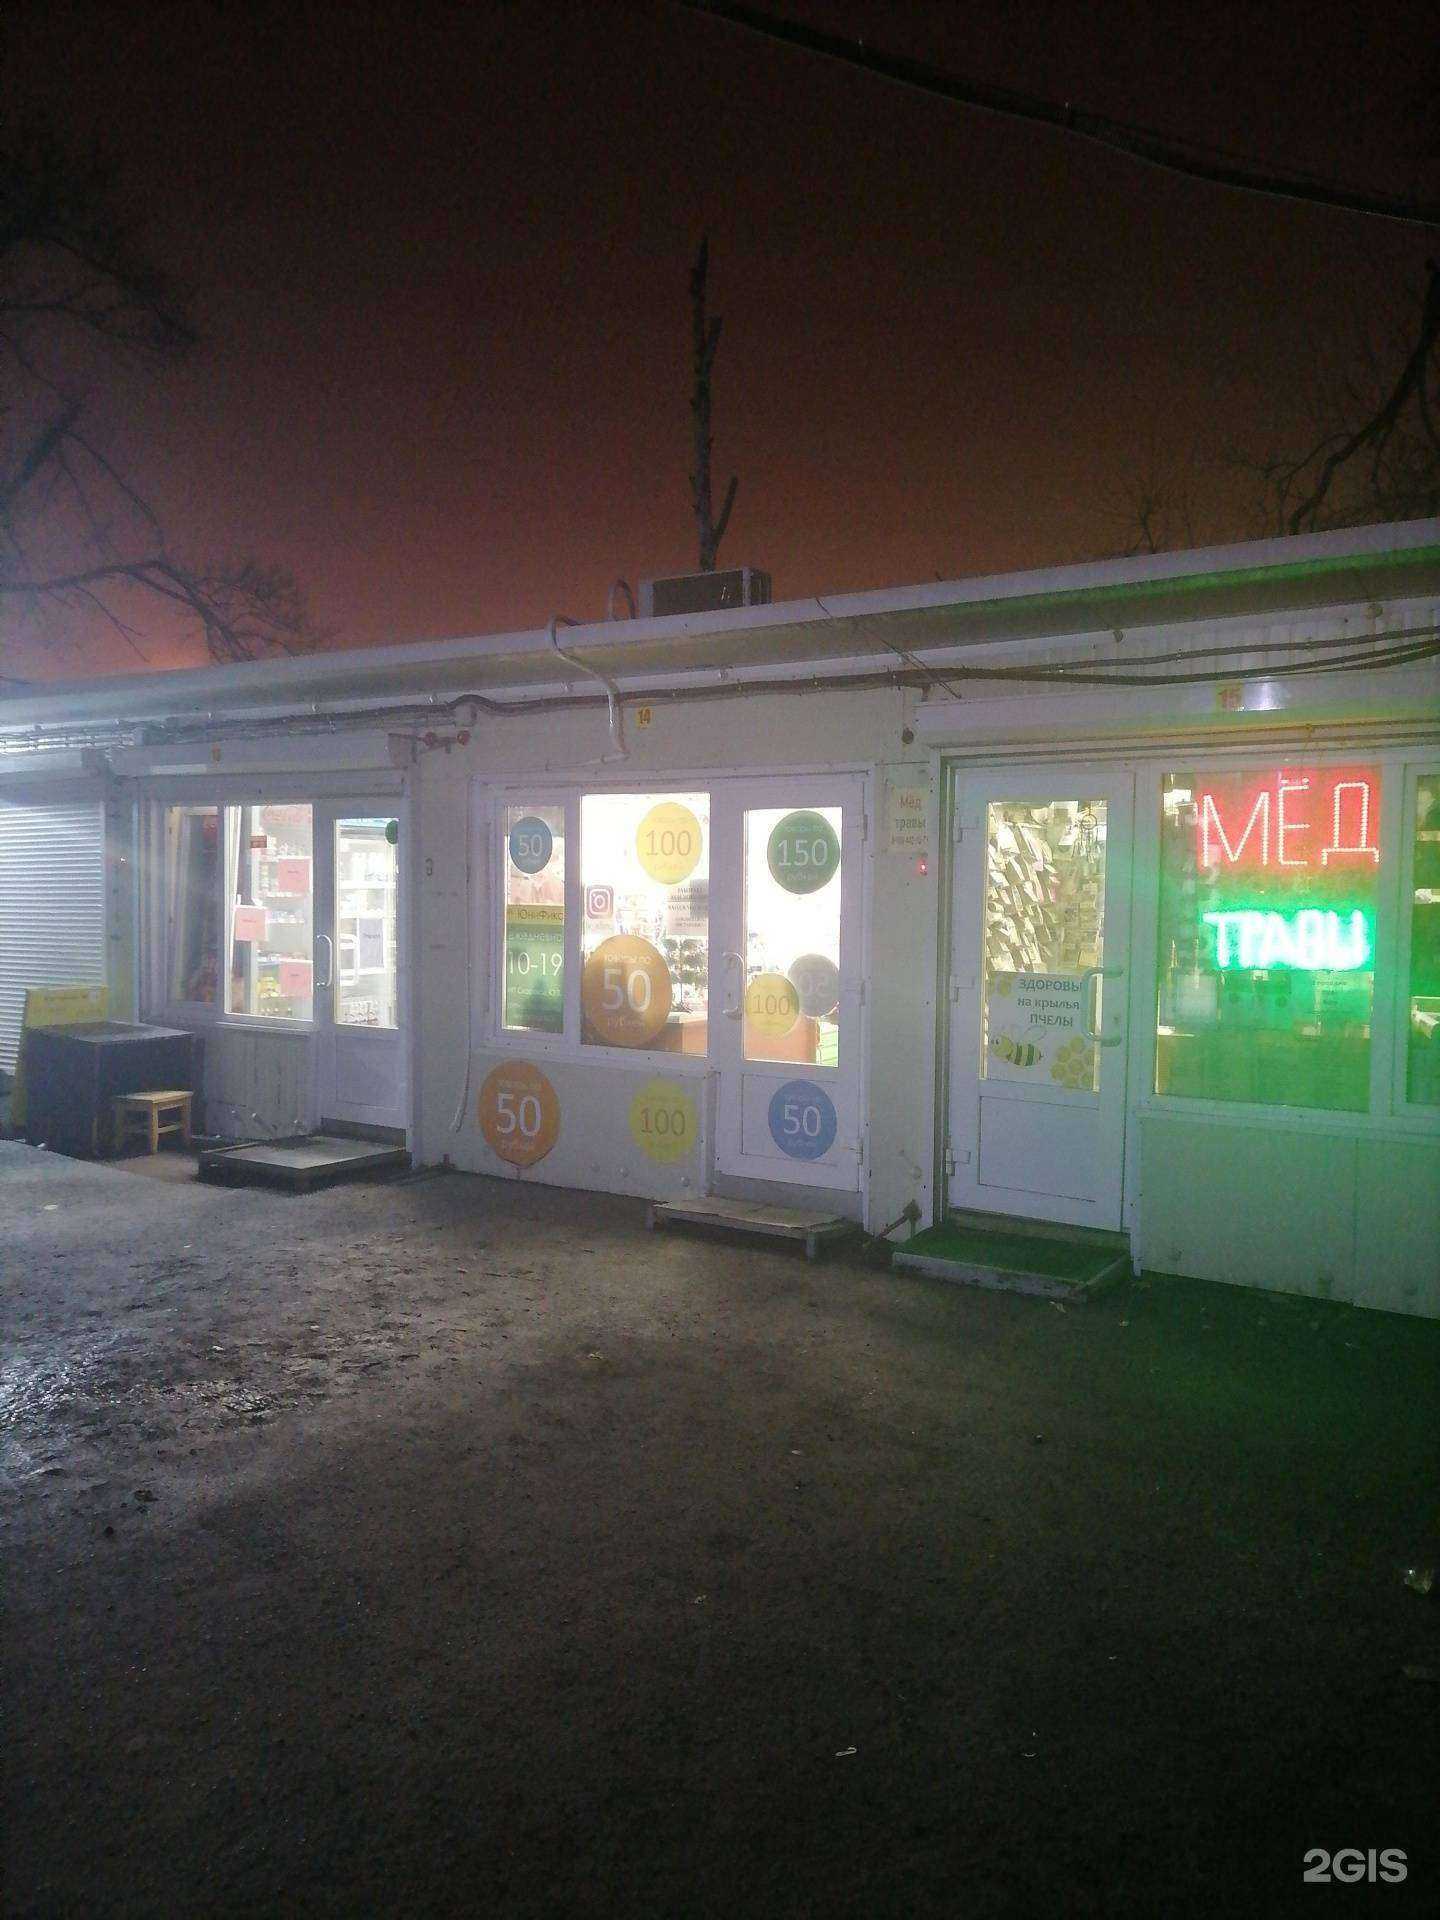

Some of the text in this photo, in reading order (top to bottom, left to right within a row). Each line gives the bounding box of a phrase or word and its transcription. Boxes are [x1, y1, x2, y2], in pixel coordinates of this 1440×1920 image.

[1202, 777, 1379, 867] МЁД
[518, 834, 543, 857] 50
[646, 830, 691, 856] 100
[777, 838, 829, 867] 150
[509, 951, 563, 976] 10-19
[602, 967, 652, 1012] 50
[753, 994, 790, 1016] 100
[1017, 997, 1080, 1011] на крылья
[1030, 1013, 1073, 1027] ПЧЕЛЫ
[497, 1093, 542, 1137] 50
[640, 1107, 686, 1136] 100
[783, 1104, 822, 1137] 50
